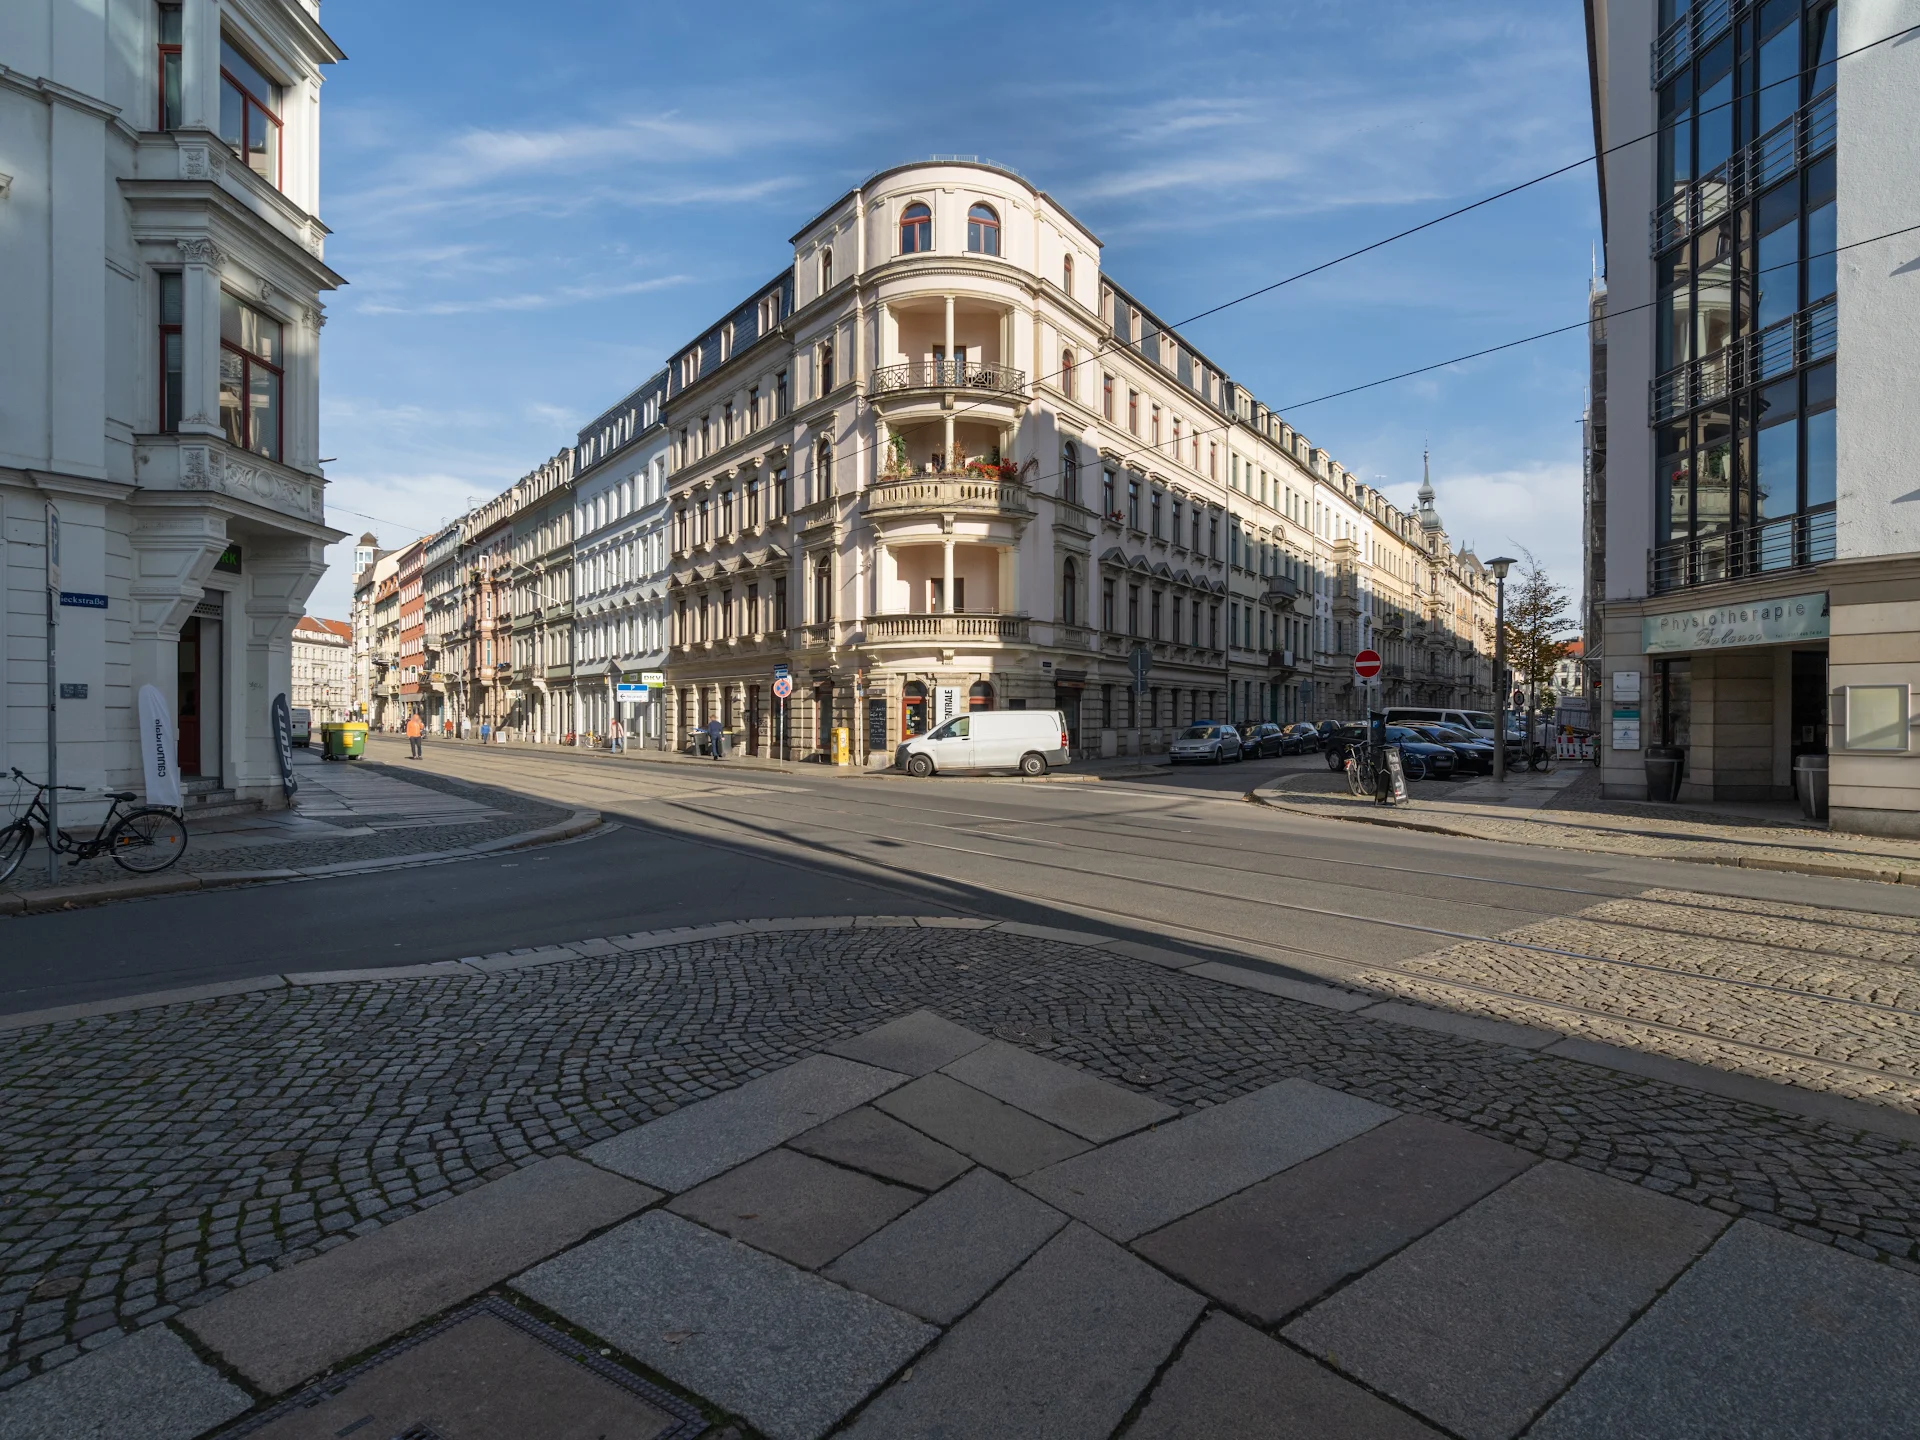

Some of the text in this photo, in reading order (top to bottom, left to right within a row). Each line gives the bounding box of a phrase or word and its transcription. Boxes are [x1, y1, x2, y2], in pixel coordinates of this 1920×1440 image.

[221, 551, 237, 566] RK
[60, 594, 105, 606] ieckstraße
[1660, 603, 1805, 632] Physiotherapie
[1693, 628, 1763, 647] Balance
[277, 704, 292, 771] SCOTT
